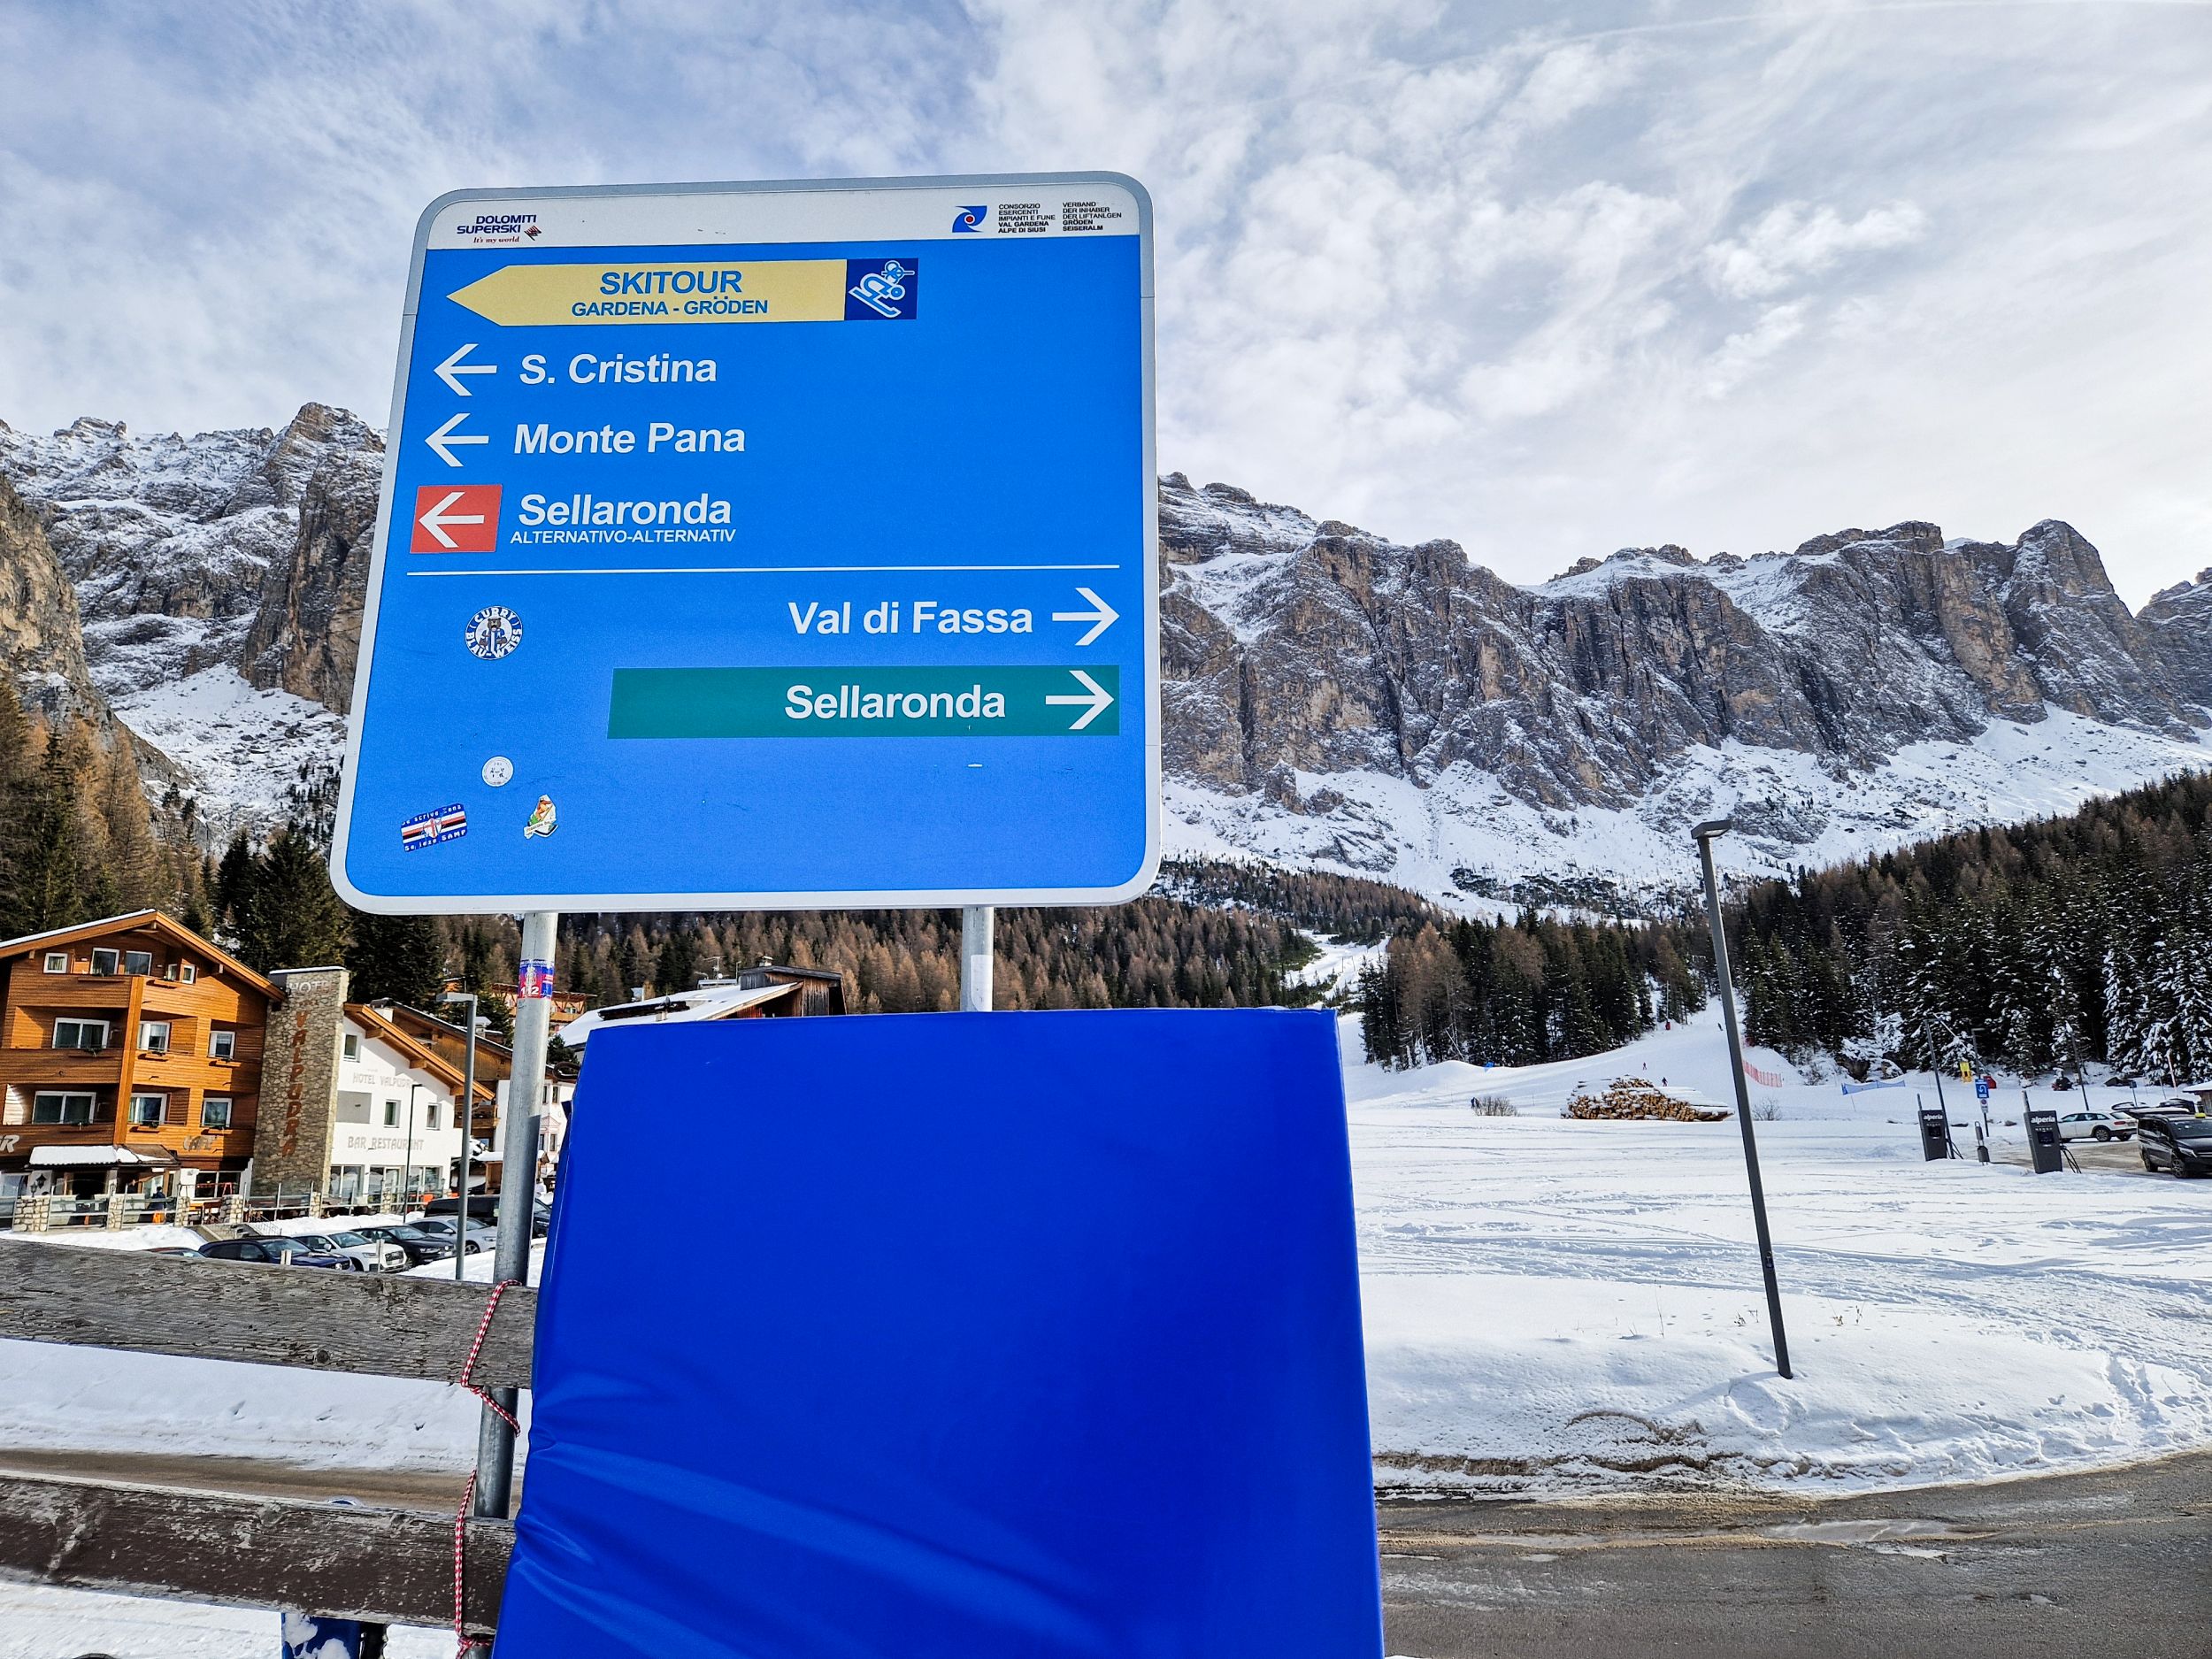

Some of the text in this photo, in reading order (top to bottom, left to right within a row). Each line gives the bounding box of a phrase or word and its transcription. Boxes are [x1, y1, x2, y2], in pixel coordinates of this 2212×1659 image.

[457, 224, 521, 234] SUPERSKI
[475, 214, 537, 225] DOLOMITI
[599, 270, 742, 296] SKITOUR
[571, 302, 669, 317] GARDENA
[683, 296, 768, 315] GRÖDEN
[518, 353, 718, 384] S. Cristina
[513, 422, 746, 454] Monte Pana
[518, 493, 732, 526] Sellaronda
[510, 529, 736, 544] ALTERNATIVO-ALTERNATIV
[787, 601, 1033, 634] Val di Fassa
[784, 684, 1006, 719] Sellaronda
[442, 829, 466, 841] SAMP
[352, 1071, 413, 1089] HOTEL VALPUDR
[2031, 1115, 2056, 1125] alperia
[347, 1136, 367, 1149] BAR
